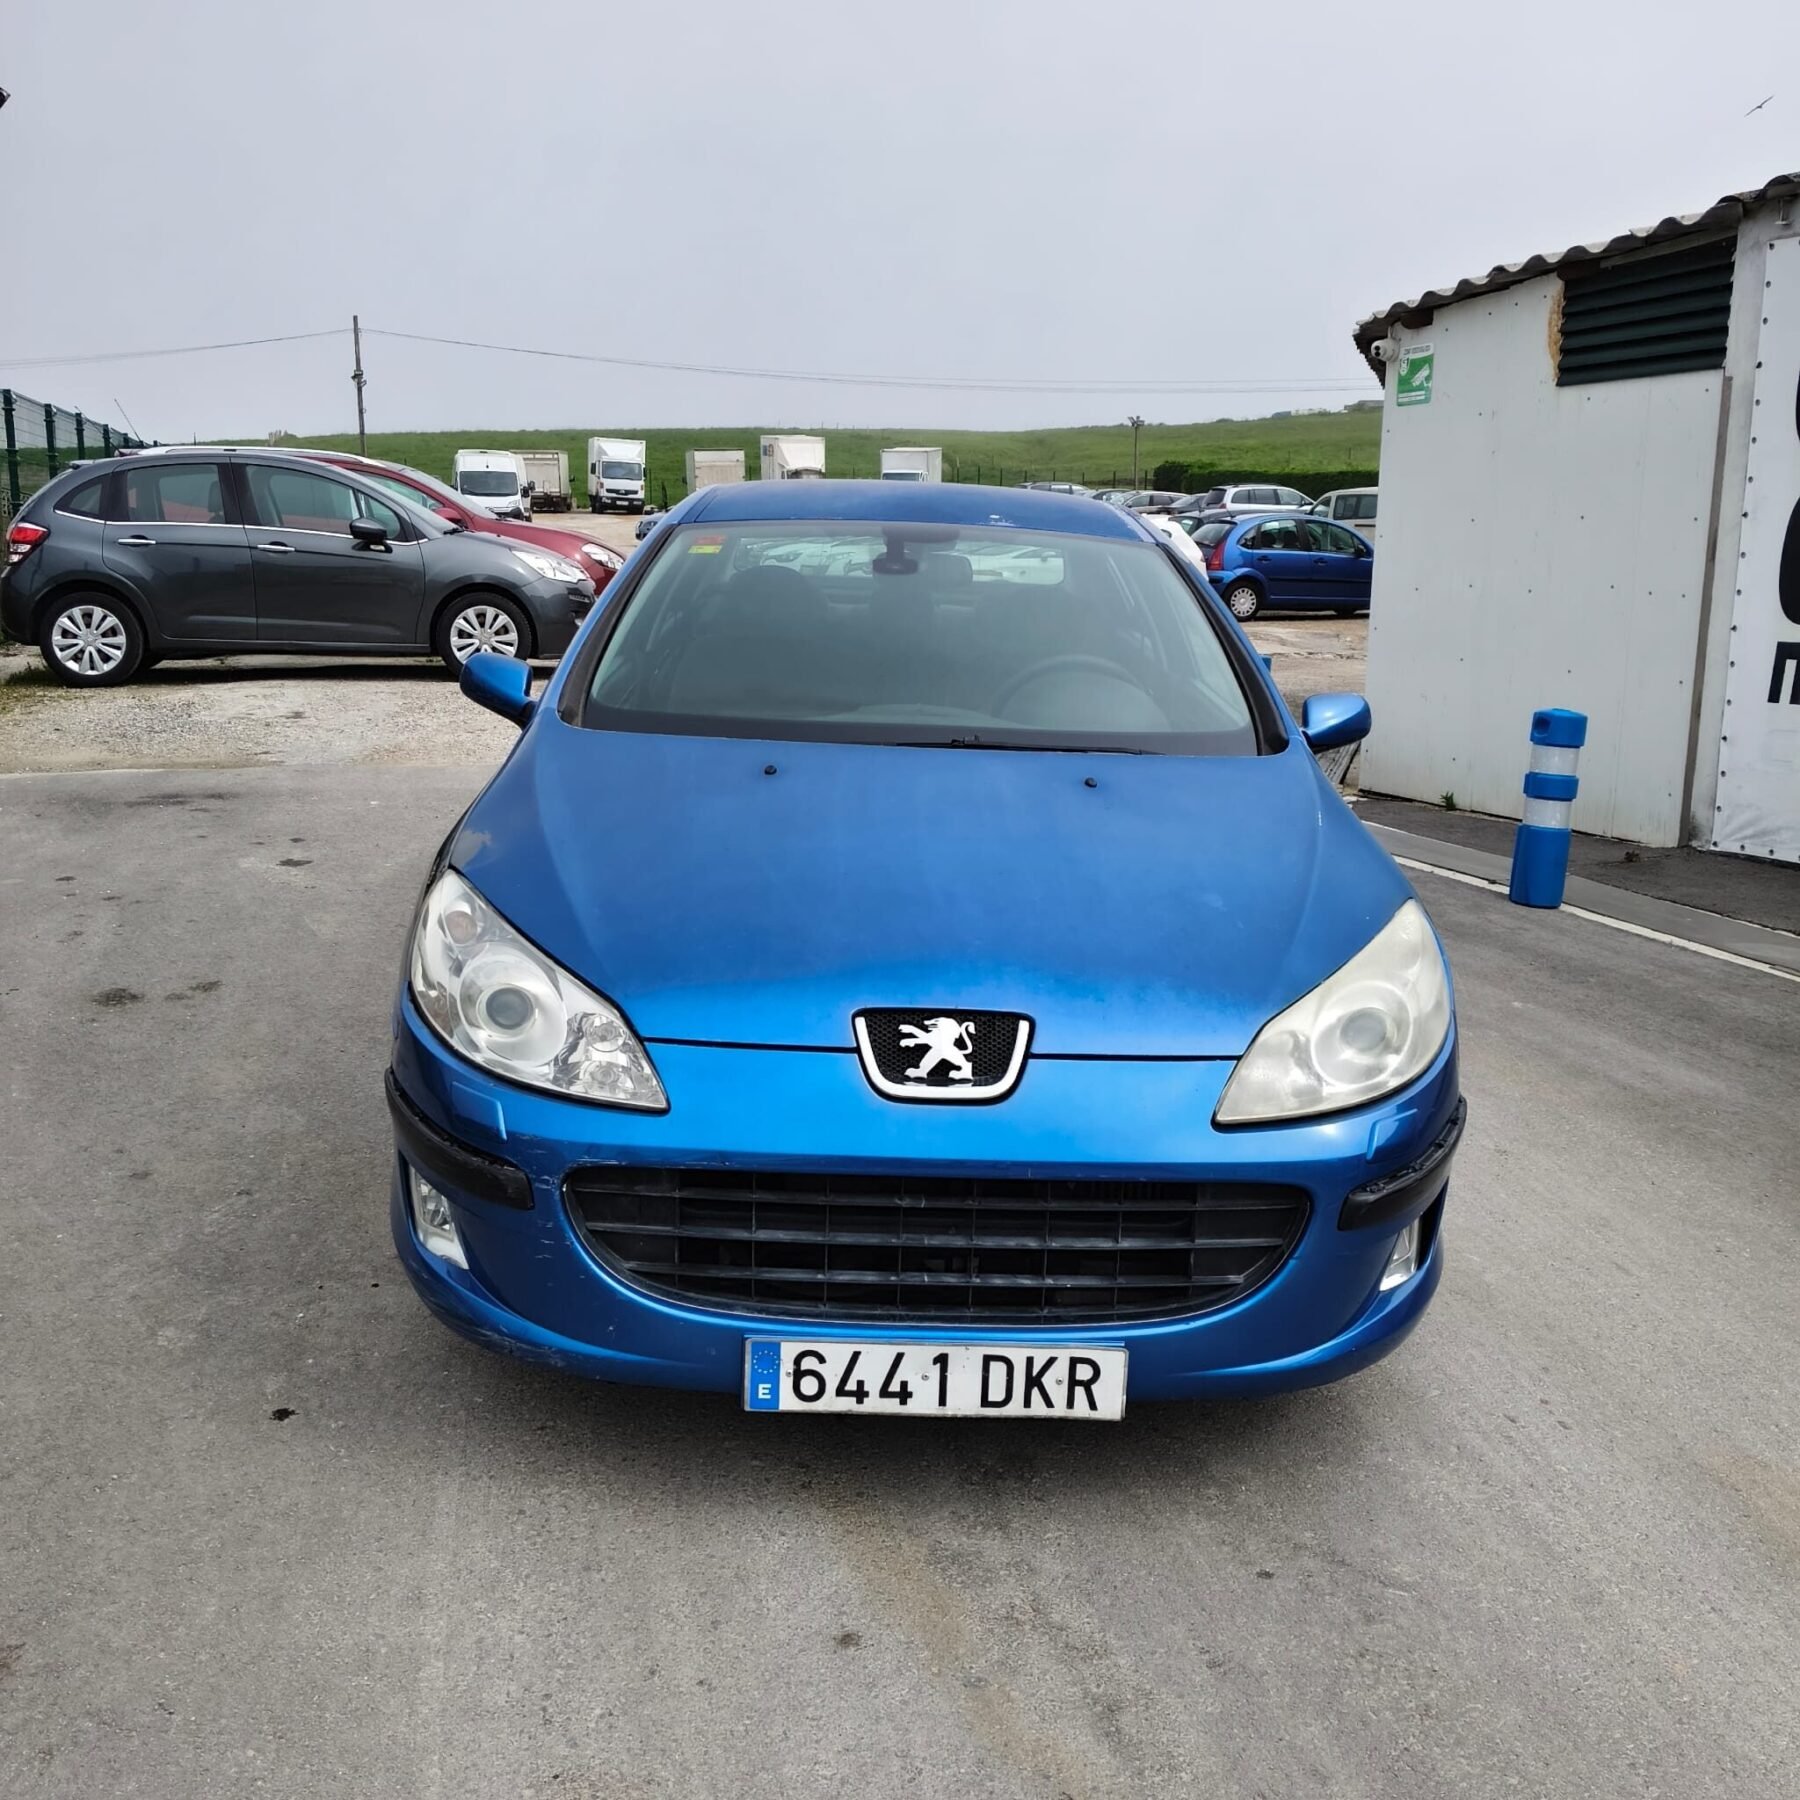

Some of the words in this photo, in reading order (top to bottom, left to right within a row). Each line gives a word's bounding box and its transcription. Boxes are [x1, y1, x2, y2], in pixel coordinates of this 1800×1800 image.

[758, 1383, 772, 1399] E
[792, 1349, 949, 1408] 6441
[980, 1353, 1101, 1411] DKR
